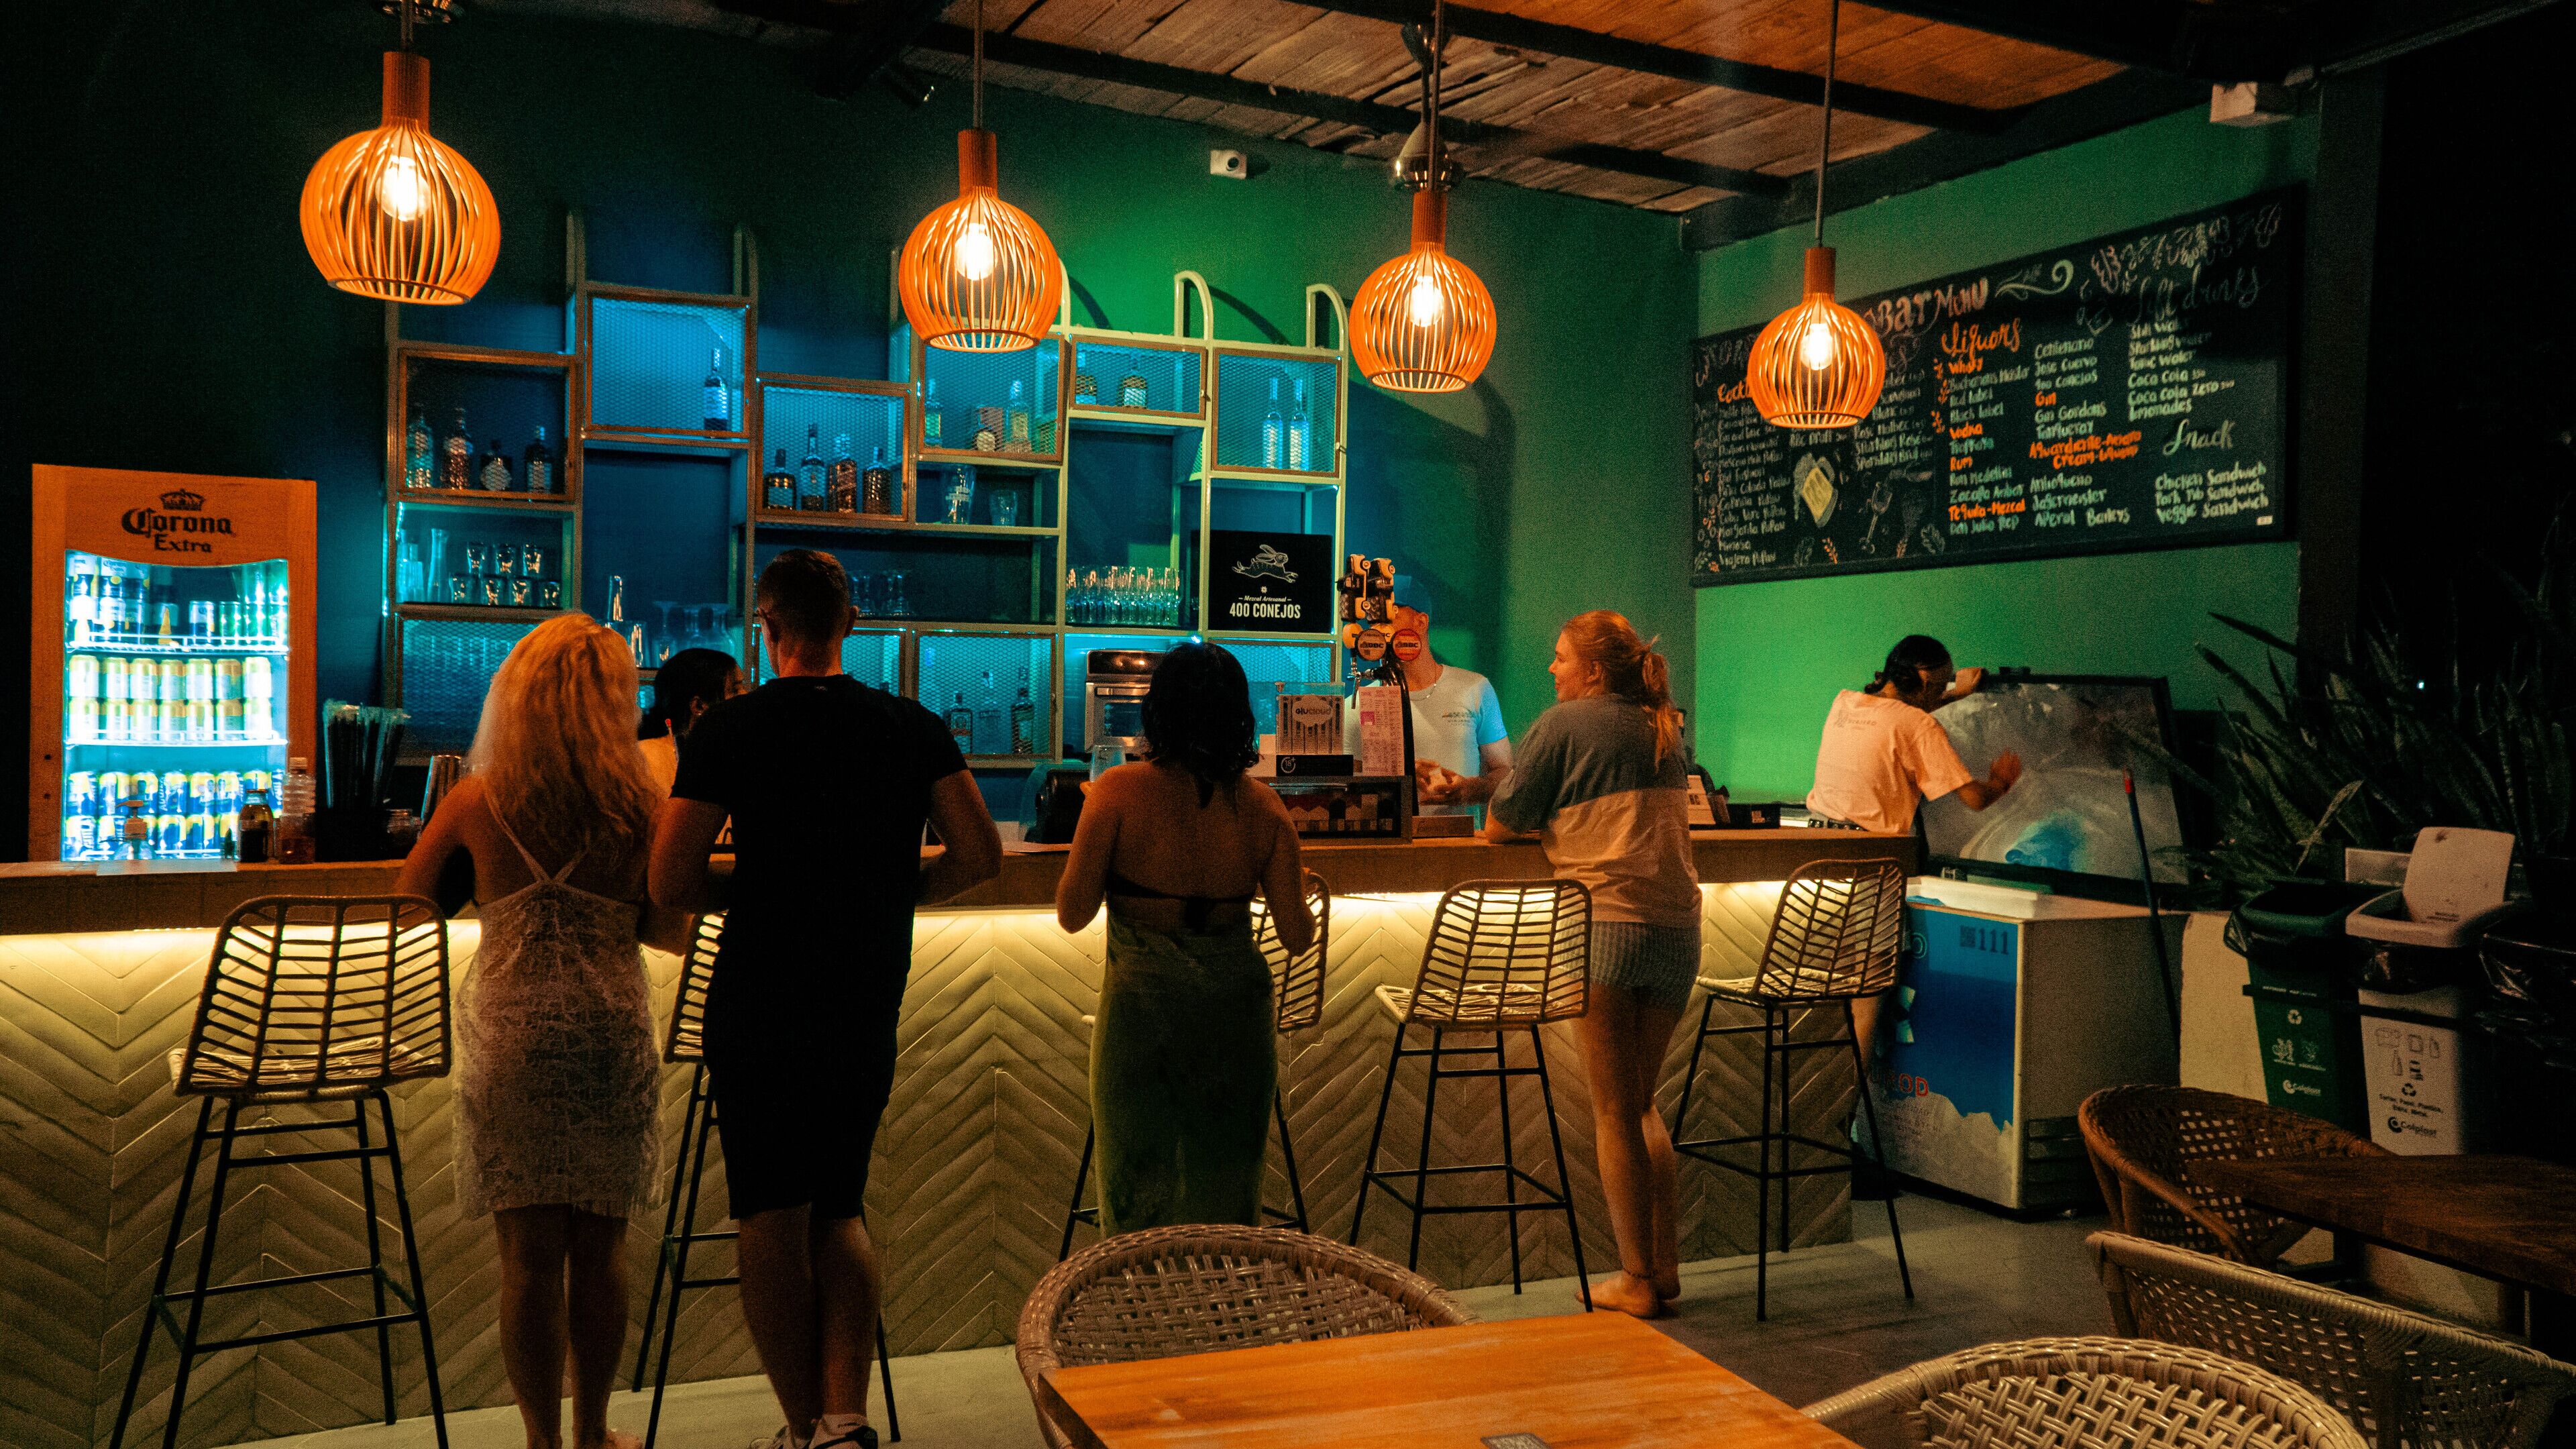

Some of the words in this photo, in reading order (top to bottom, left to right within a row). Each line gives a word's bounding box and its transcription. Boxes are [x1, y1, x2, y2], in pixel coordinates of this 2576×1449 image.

[1941, 318, 2020, 366] Liquors
[2128, 372, 2158, 389] Coca
[2161, 368, 2188, 384] Cola
[2035, 390, 2057, 407] Gin
[2128, 390, 2157, 406] Coca
[2163, 419, 2236, 456] Snack
[1949, 456, 1973, 472] Rum
[121, 507, 233, 537] Corona
[154, 533, 211, 553] Extra
[1229, 602, 1250, 617] 400
[1252, 602, 1301, 619] CONEJOS
